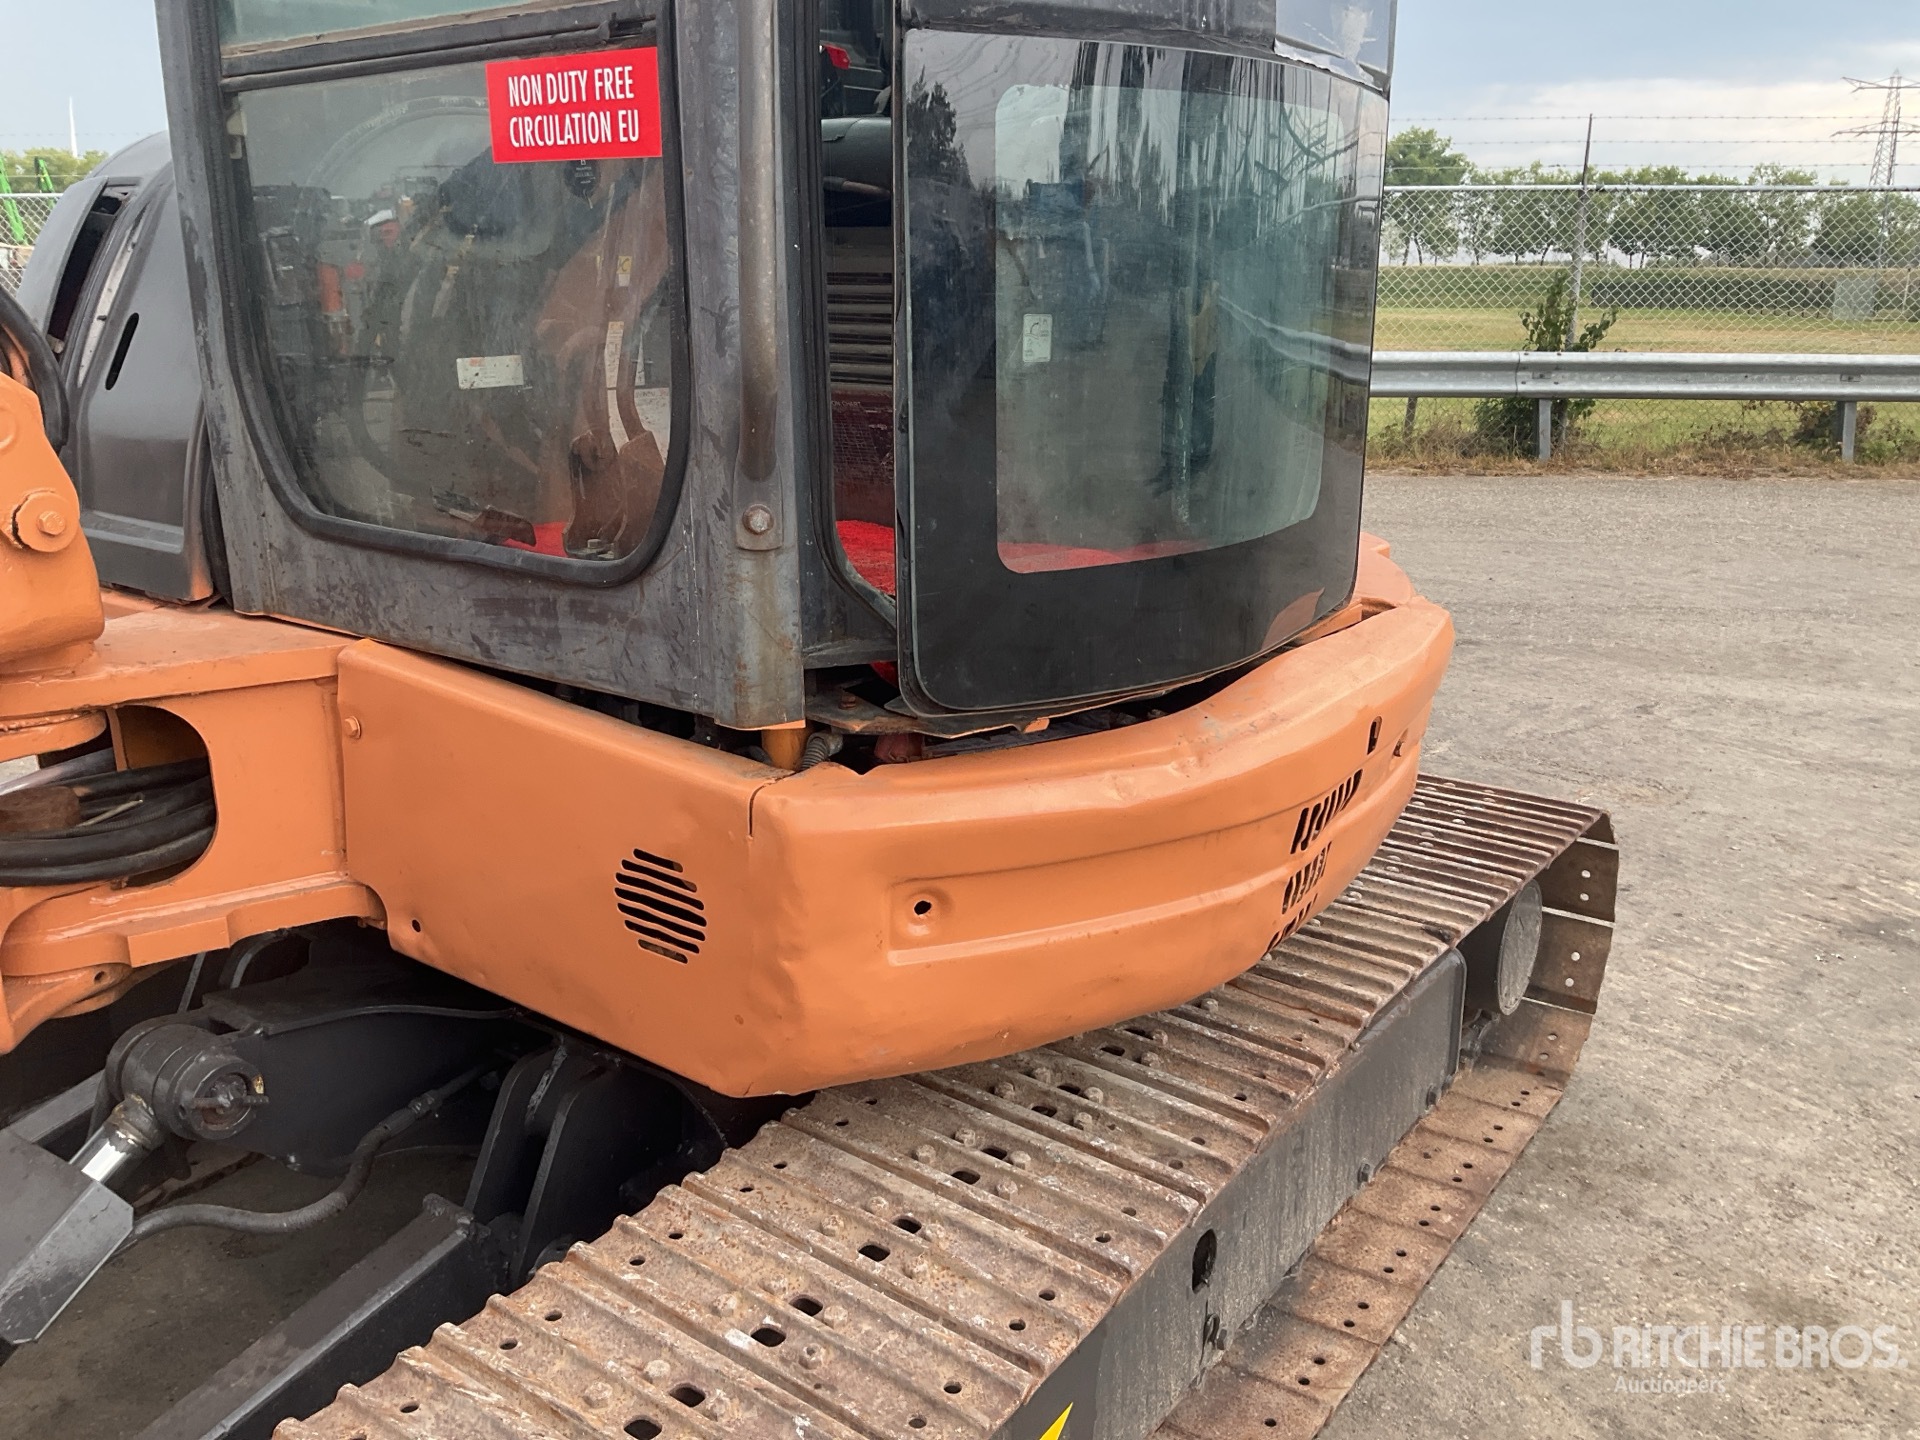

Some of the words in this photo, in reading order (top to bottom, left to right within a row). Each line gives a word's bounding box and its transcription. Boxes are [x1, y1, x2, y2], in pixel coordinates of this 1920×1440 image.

[508, 74, 542, 107] NON
[545, 70, 588, 104] DUTY
[594, 66, 634, 100] FREE
[509, 111, 612, 148] CIRCULATION
[618, 109, 639, 142] EU
